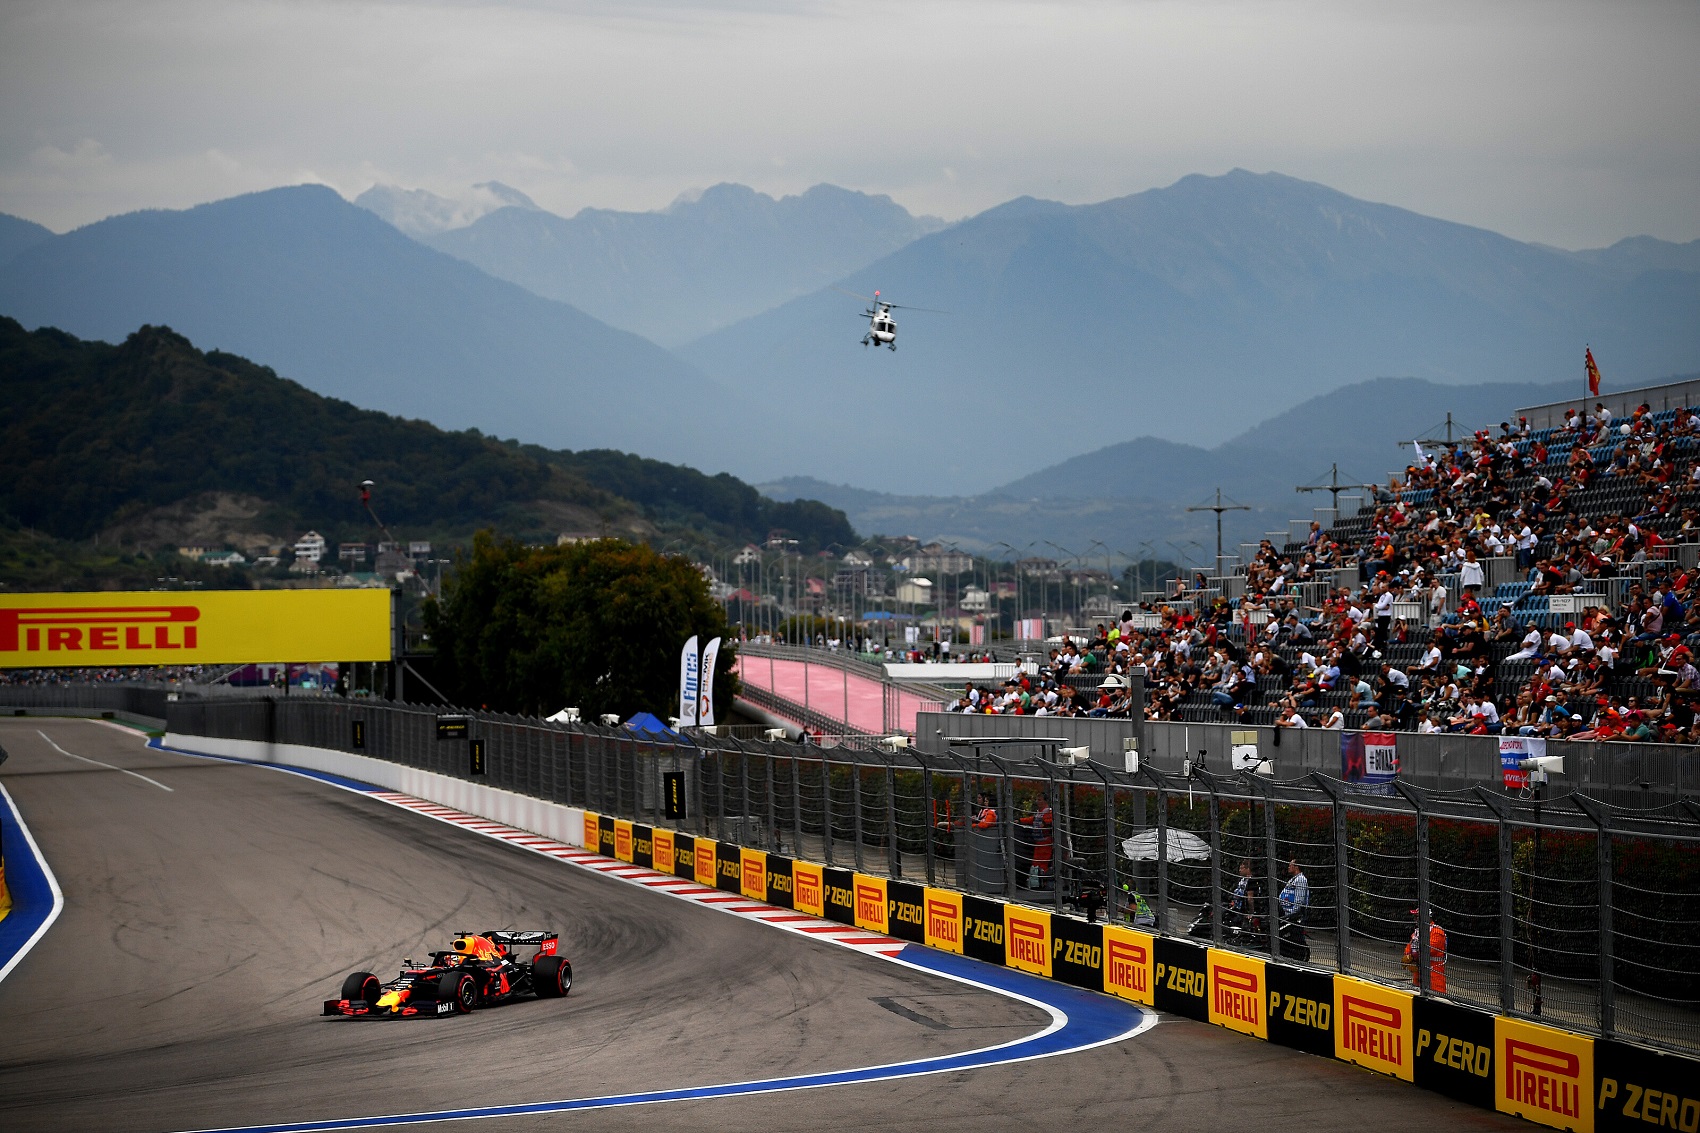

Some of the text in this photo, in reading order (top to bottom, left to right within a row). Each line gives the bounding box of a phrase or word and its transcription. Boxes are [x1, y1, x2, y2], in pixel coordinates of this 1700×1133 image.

[0, 606, 200, 651] PIRELLI
[674, 848, 694, 867] P ZERO
[697, 847, 714, 879] PIRELLI
[717, 859, 740, 879] P ZERO
[743, 858, 764, 893] PIRELLI
[767, 871, 792, 893] P ZERO
[796, 871, 820, 908] PIRELLI
[825, 885, 853, 908] P ZERO
[857, 885, 883, 924] PIRELLI
[889, 900, 922, 925] P ZERO
[928, 899, 957, 943] PIRELLI
[964, 917, 1003, 944] P ZERO
[1010, 918, 1045, 966] PIRELLI
[1053, 937, 1101, 969] P ZERO
[1109, 940, 1146, 992] PIRELLI
[1155, 963, 1205, 998] P ZERO
[1214, 965, 1258, 1025] PIRELLI
[1269, 991, 1331, 1031] P ZERO
[1342, 995, 1402, 1066] PIRELLI
[1416, 1028, 1491, 1078] P ZERO
[1505, 1038, 1579, 1119] PIRELLI
[1598, 1077, 1700, 1133] P ZERO
